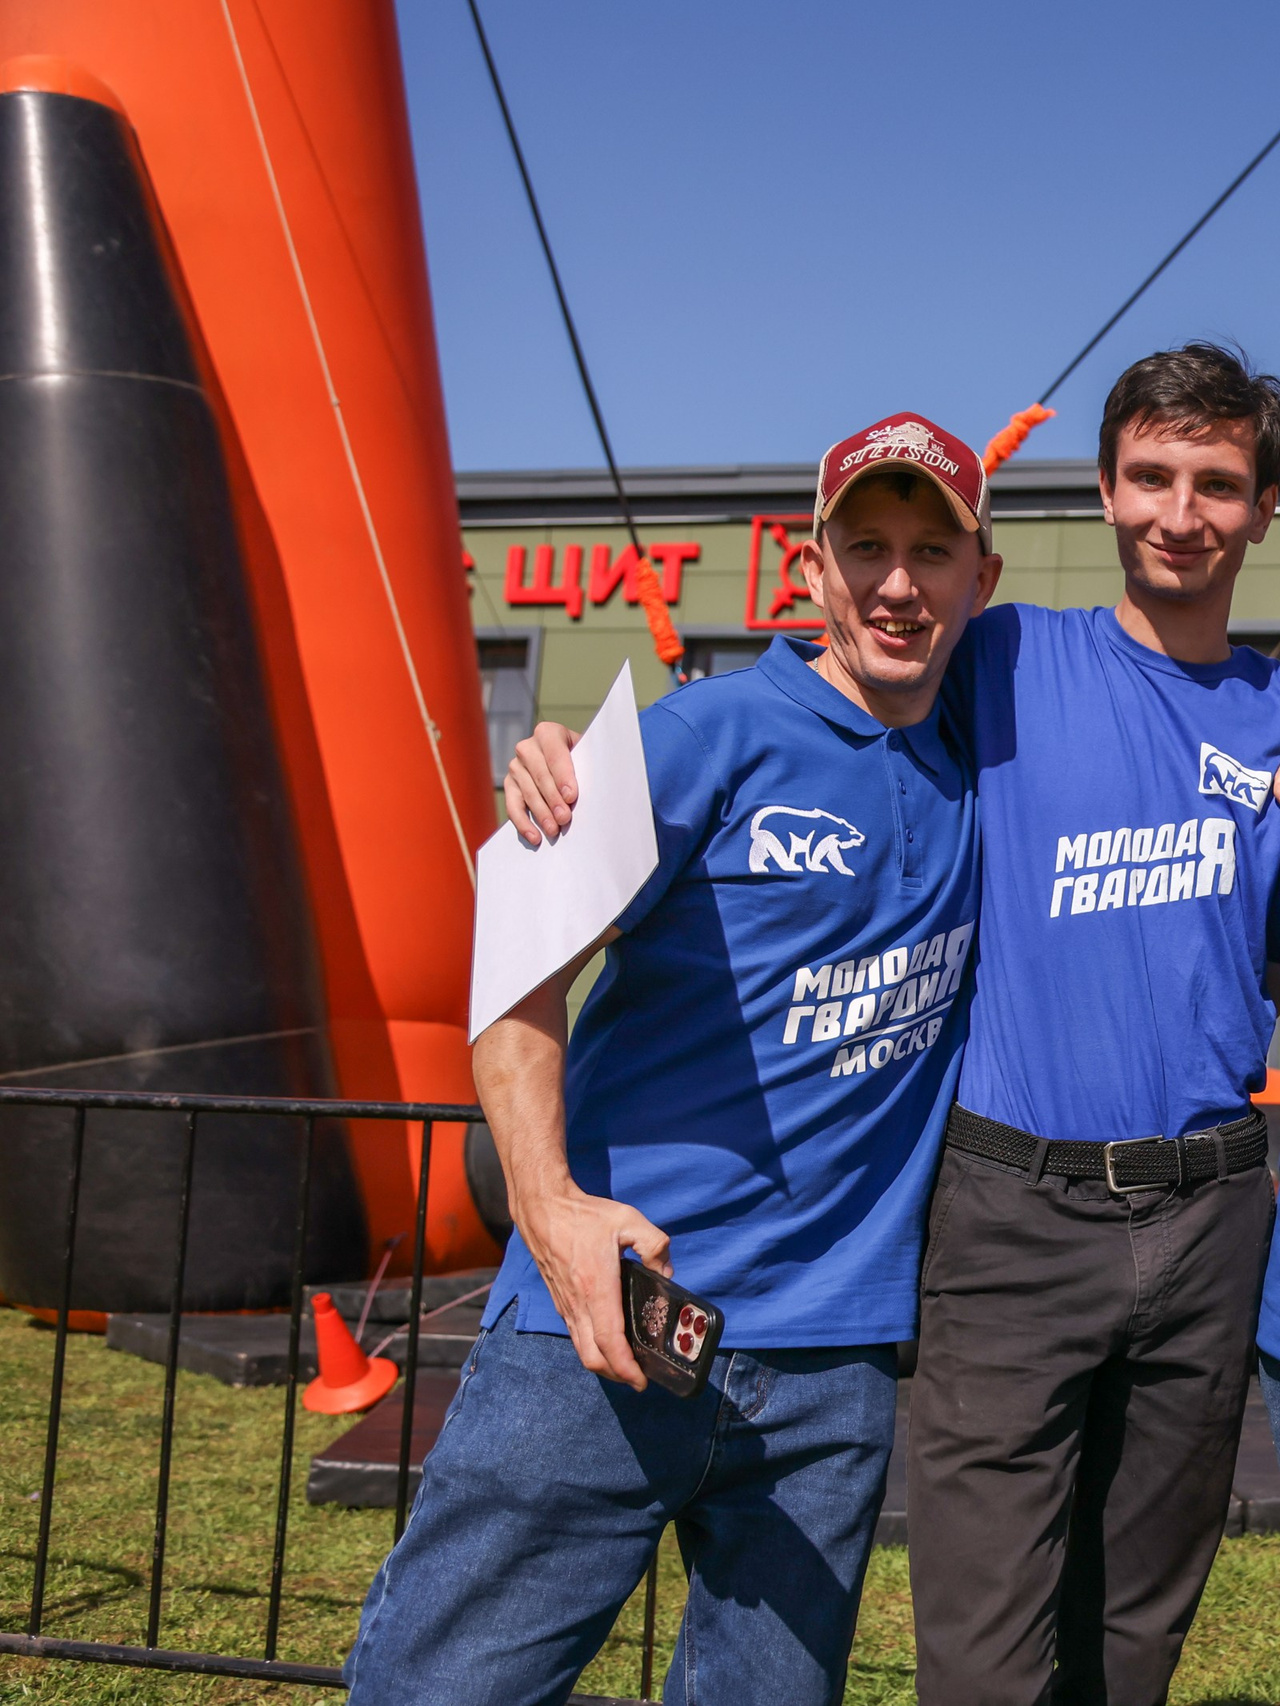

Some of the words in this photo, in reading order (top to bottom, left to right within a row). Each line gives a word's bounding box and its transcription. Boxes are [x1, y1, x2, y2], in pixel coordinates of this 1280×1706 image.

[839, 443, 960, 477] STETSON
[504, 542, 700, 619] ЩИТ
[1050, 843, 1236, 918] ГВАРДИЯ
[1055, 818, 1236, 881] МОЛОДАЯ
[792, 919, 975, 1001] МОЛОДАЯ
[830, 1016, 943, 1078] МОСКВ
